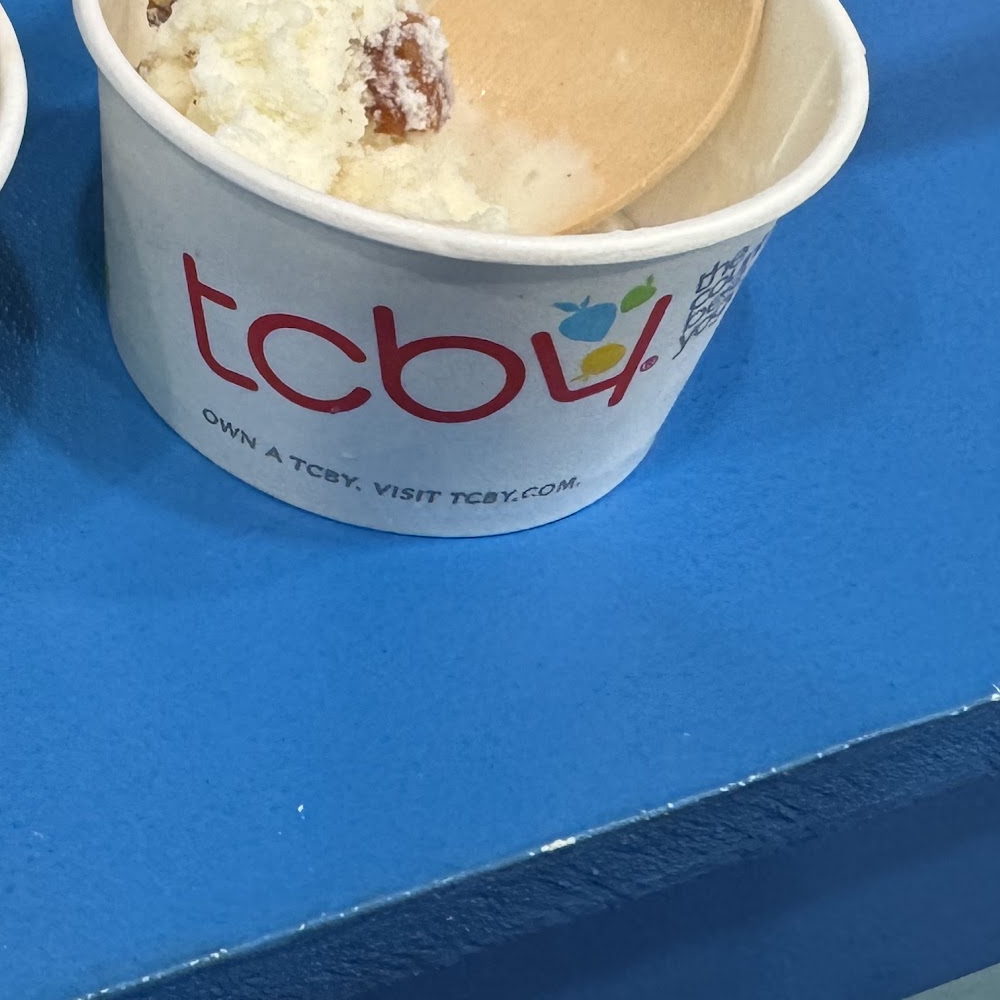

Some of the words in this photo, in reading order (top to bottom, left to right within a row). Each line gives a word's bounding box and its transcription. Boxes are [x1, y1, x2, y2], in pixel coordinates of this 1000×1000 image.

[183, 252, 673, 424] tcby
[202, 408, 257, 449] OWN
[265, 446, 283, 463] A
[289, 455, 361, 491] TCBY.
[373, 482, 442, 503] VISIT
[450, 476, 581, 505] TCBY.COM.
